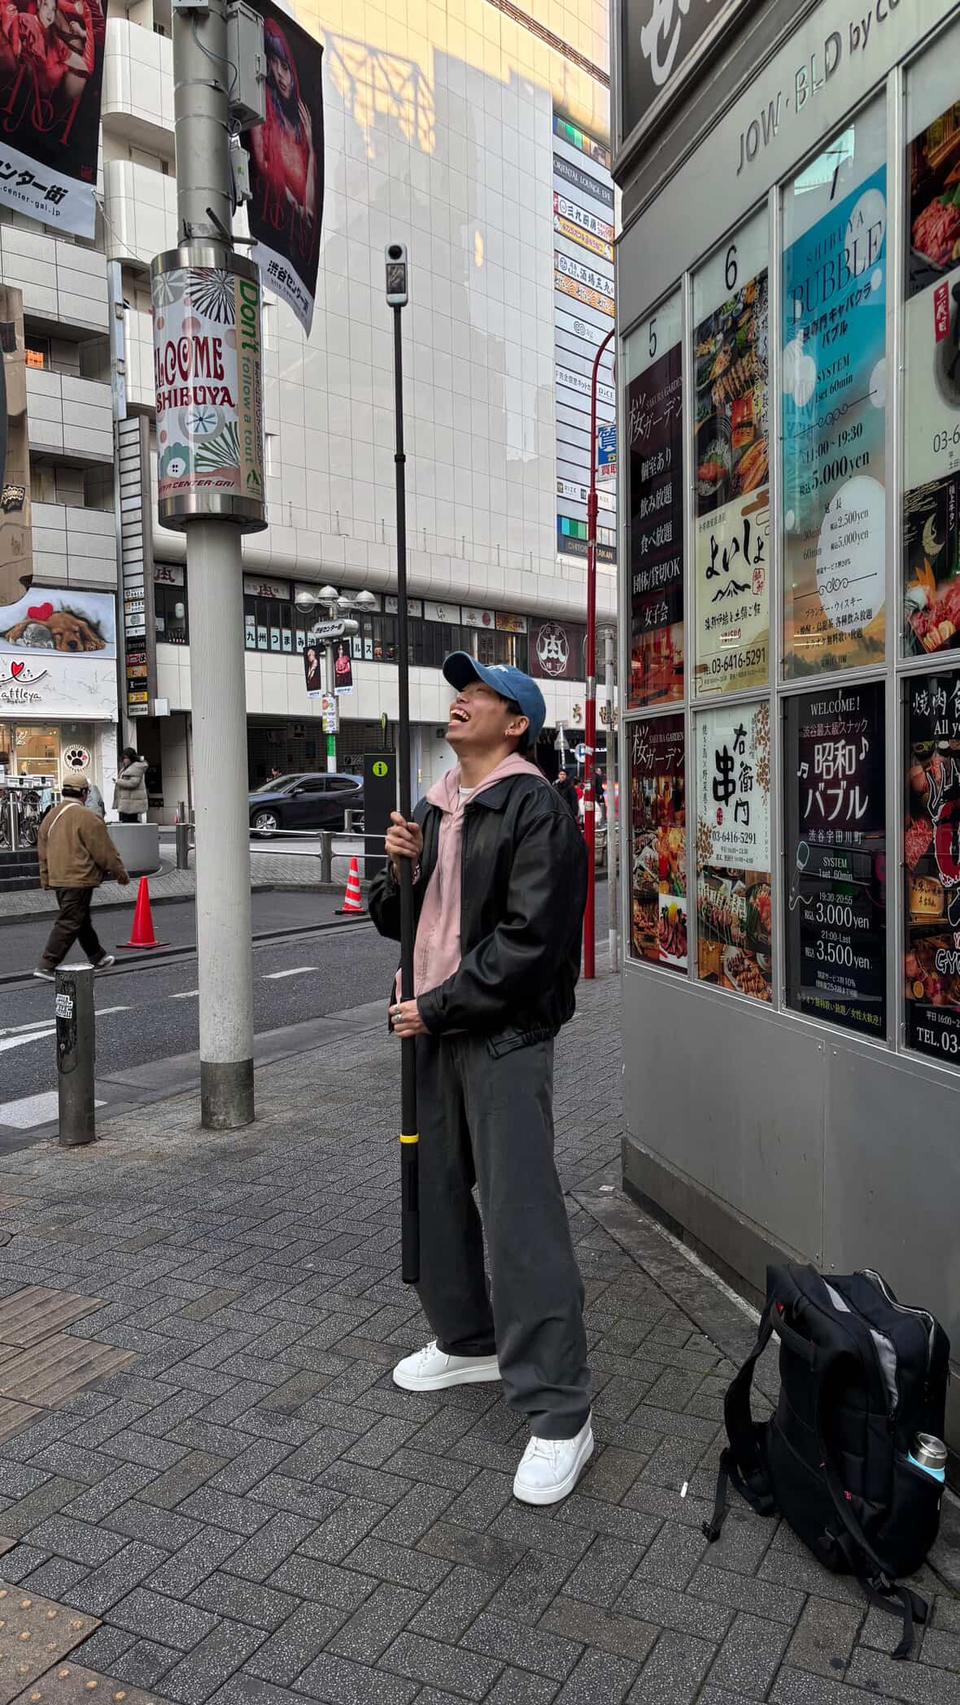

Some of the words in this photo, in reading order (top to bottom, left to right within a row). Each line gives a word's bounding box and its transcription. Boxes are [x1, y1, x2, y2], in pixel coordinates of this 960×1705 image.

[849, 11, 872, 55] by
[0, 160, 69, 205] ンター街
[725, 245, 738, 290] 6
[790, 221, 882, 323] BUBBLE
[648, 319, 657, 358] 5
[816, 353, 851, 384] SYSTEM
[156, 386, 235, 413] SHIBUYA
[934, 719, 949, 735] All
[952, 722, 960, 738] y
[814, 739, 856, 780] 昭和
[803, 781, 869, 821] バブル
[823, 857, 847, 868] SYSTEM
[935, 948, 960, 975] GY
